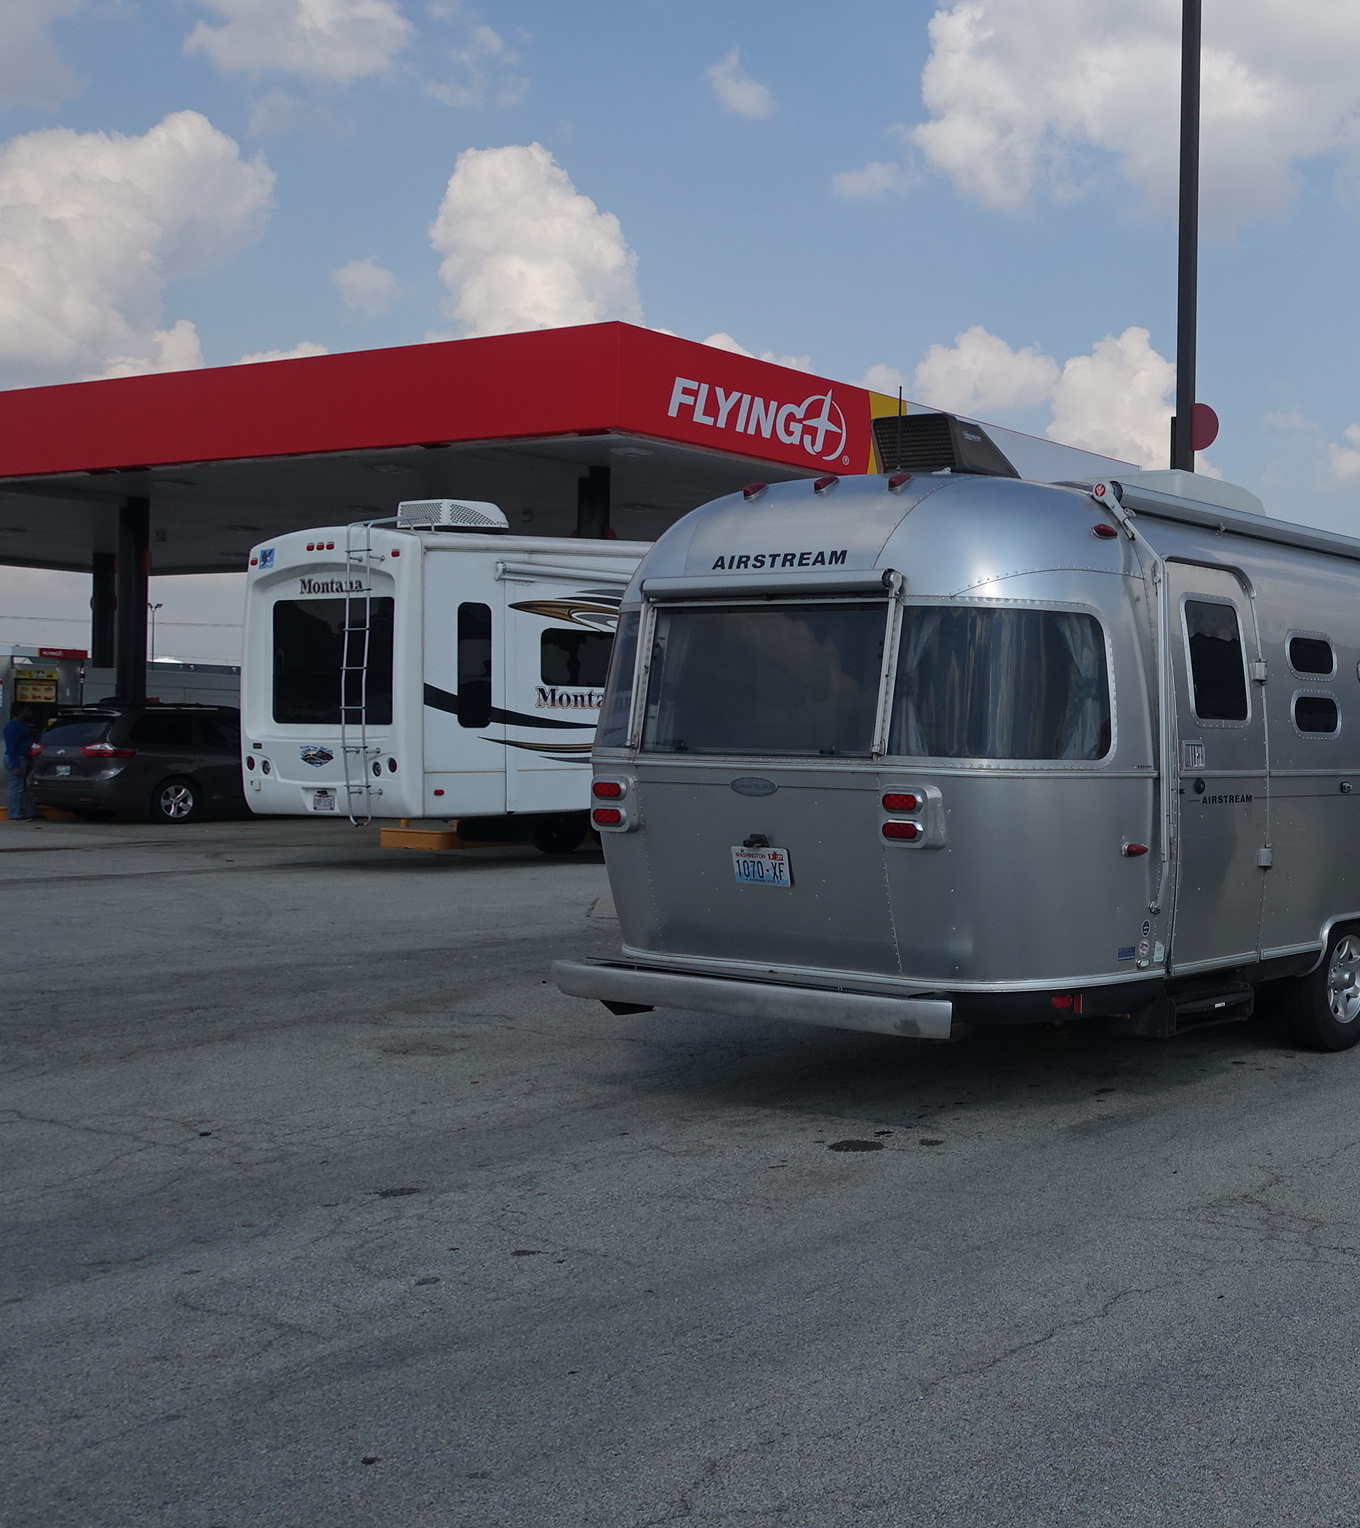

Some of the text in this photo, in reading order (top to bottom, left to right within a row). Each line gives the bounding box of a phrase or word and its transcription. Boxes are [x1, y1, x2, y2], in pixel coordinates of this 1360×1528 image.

[711, 549, 848, 571] AIRSTREAM
[300, 578, 363, 594] Montana
[534, 686, 604, 709] Monta
[1202, 795, 1253, 805] AIRSTREAM
